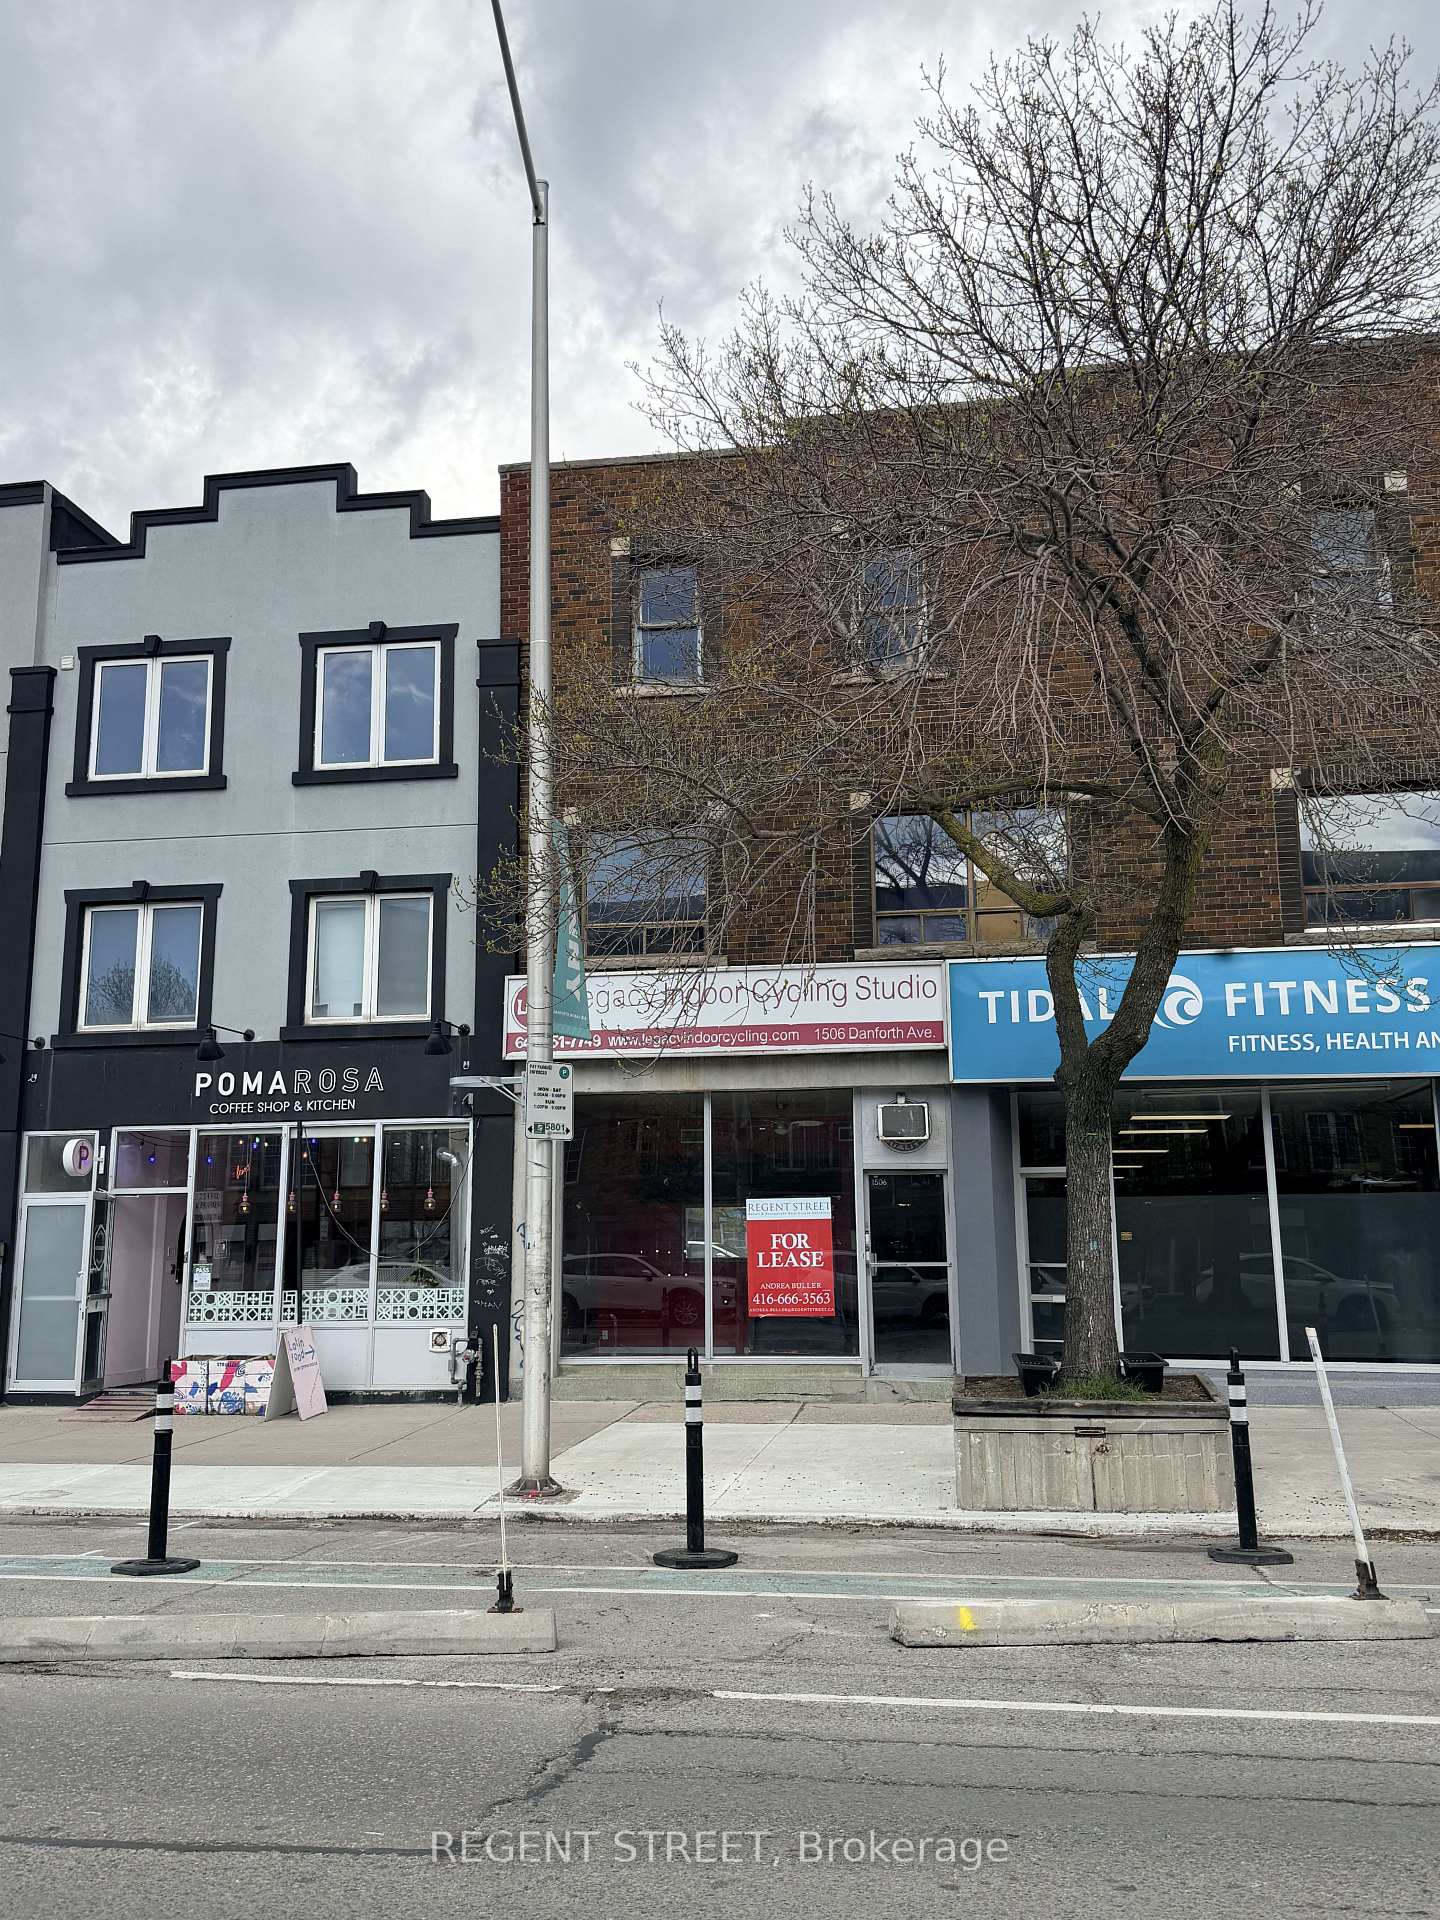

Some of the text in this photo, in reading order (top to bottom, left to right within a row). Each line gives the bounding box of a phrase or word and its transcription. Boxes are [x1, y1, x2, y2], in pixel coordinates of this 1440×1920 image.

[587, 974, 937, 1014] egacy Indoor Cycling Studio
[1225, 977, 1431, 1017] FITNESS
[608, 1030, 800, 1047] www.legacyindoorcycling.com
[814, 1027, 846, 1040] 1506
[848, 1026, 904, 1040] Danforth
[907, 1026, 936, 1039] Ave.
[1228, 1033, 1321, 1053] FITNESS,
[1326, 1031, 1409, 1050] HEALTH
[209, 1099, 356, 1114] COFFEE SHOP & KITCHEN
[545, 1122, 565, 1132] 5801
[748, 1201, 830, 1212] REGENT STREET
[770, 1233, 811, 1249] FOR
[757, 1251, 824, 1268] LEASE
[752, 1292, 831, 1305] 416-666-3563
